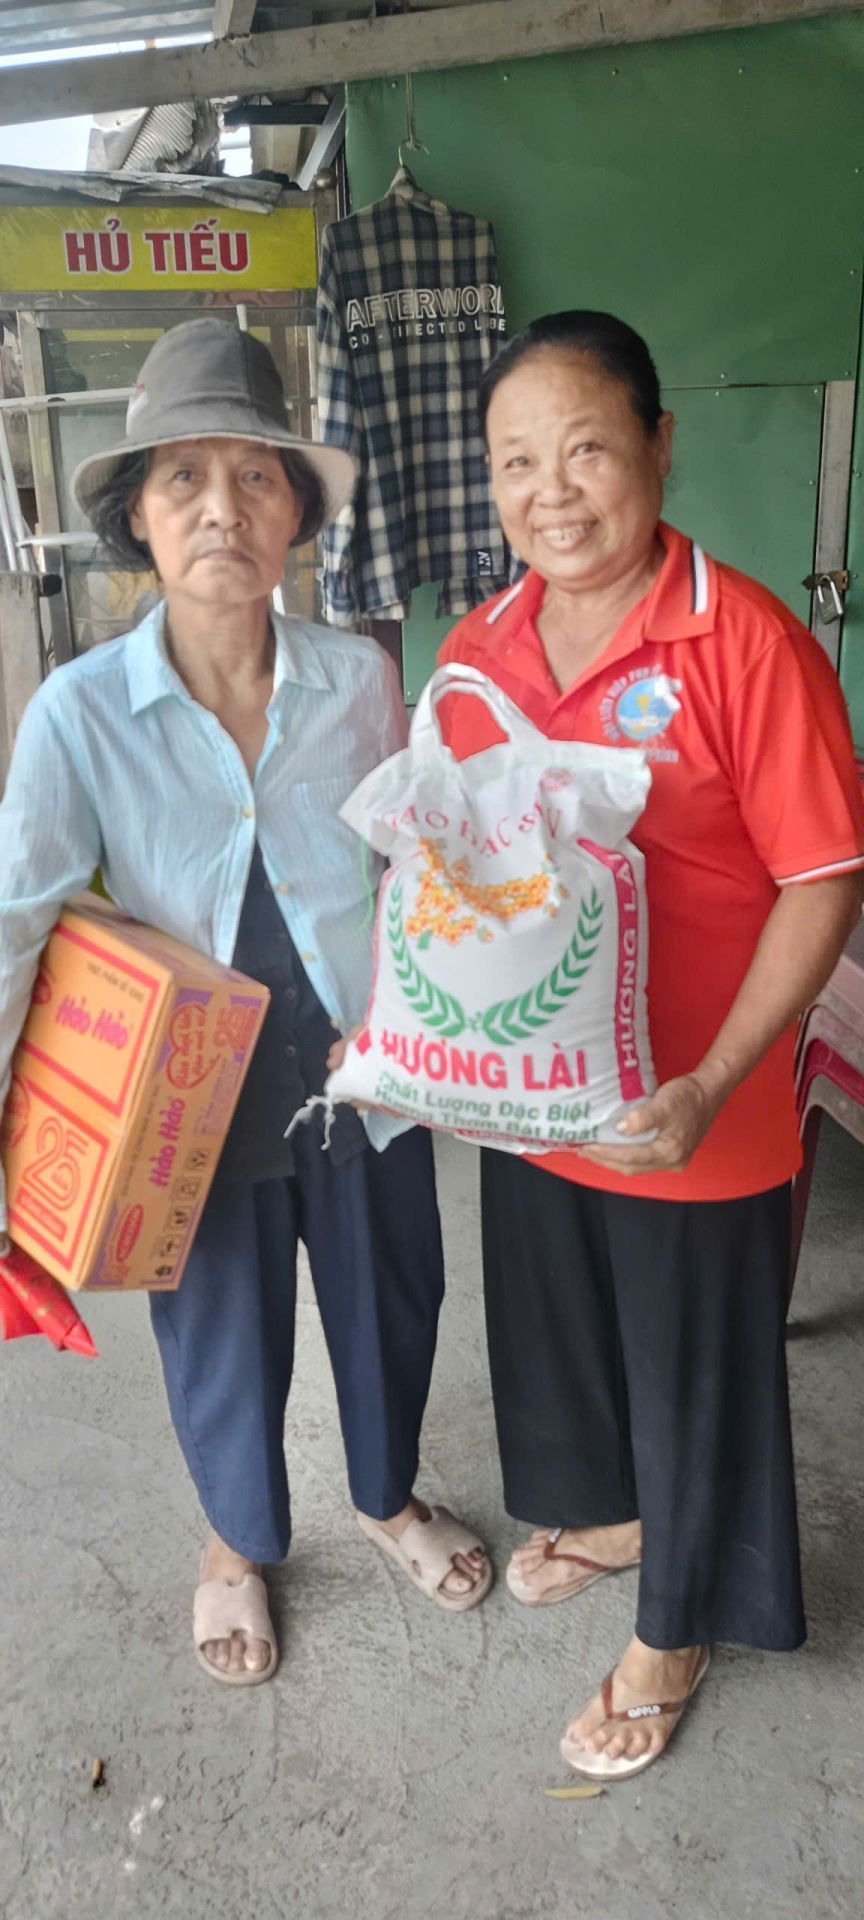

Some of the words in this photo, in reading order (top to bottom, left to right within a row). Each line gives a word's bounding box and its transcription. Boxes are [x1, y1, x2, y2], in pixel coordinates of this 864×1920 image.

[65, 218, 131, 272] HỦ
[144, 219, 249, 272] TIẾU
[380, 1028, 508, 1090] HƯƠNG
[522, 1041, 588, 1091] LÀI
[546, 1100, 590, 1125] Biệt
